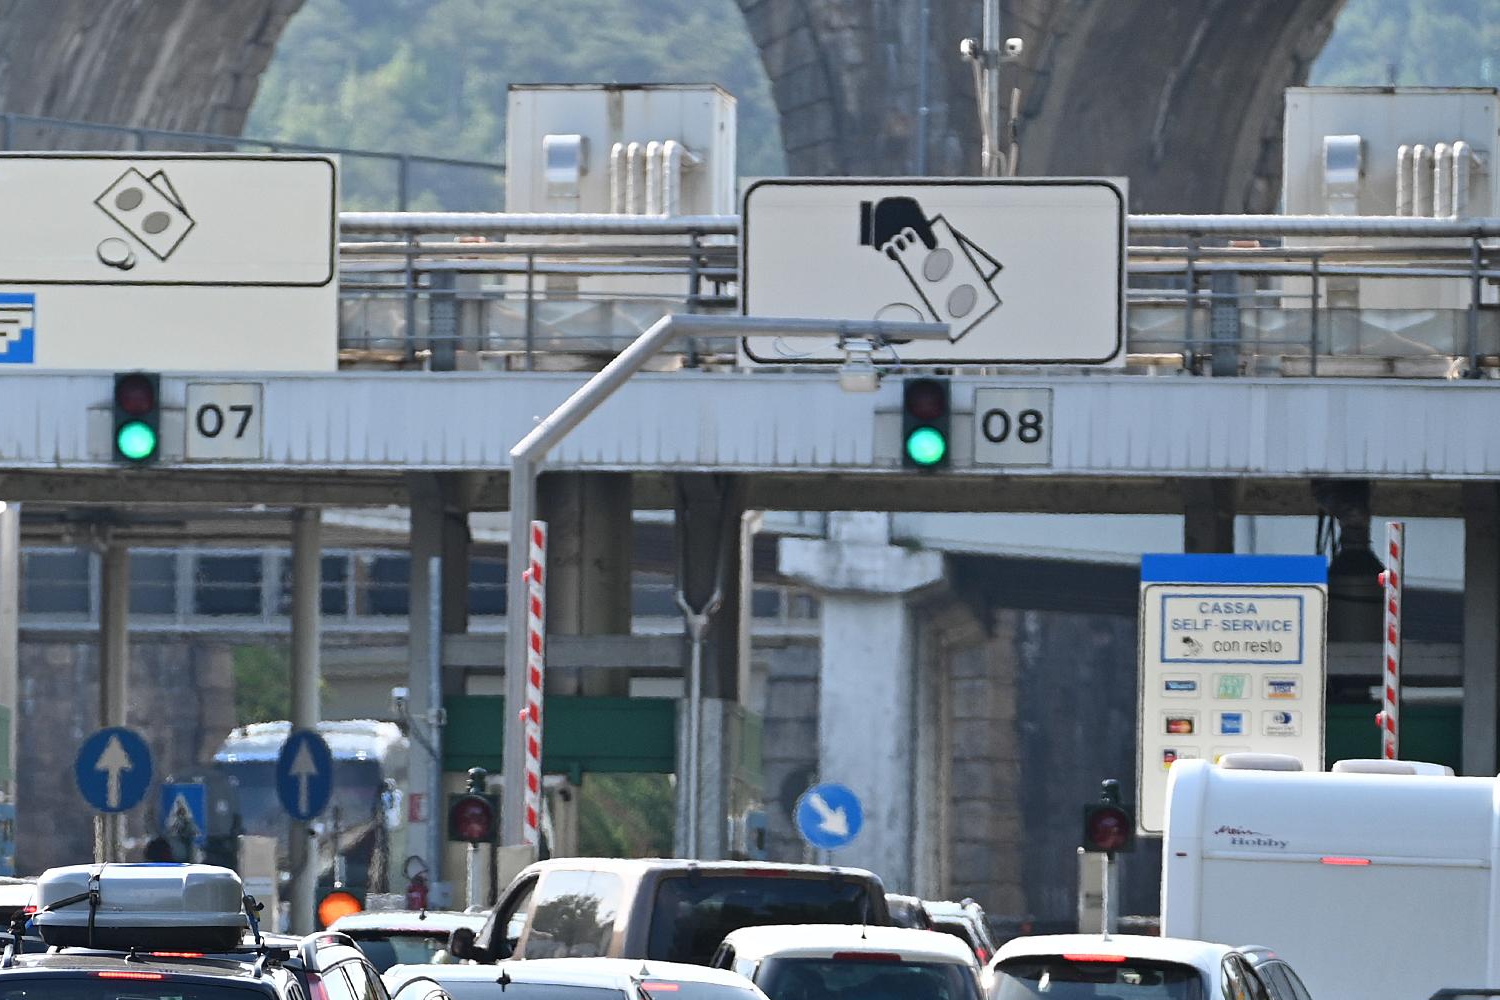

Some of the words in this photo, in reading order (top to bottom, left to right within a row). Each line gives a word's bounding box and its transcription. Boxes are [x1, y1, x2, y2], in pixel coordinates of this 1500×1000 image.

[196, 404, 253, 438] 07
[982, 409, 1043, 443] 08
[1199, 602, 1257, 614] CASSA
[1172, 618, 1292, 631] SELF-SERVICE
[1213, 640, 1239, 652] con
[1245, 639, 1282, 652] resto
[1231, 837, 1289, 848] Hobby
